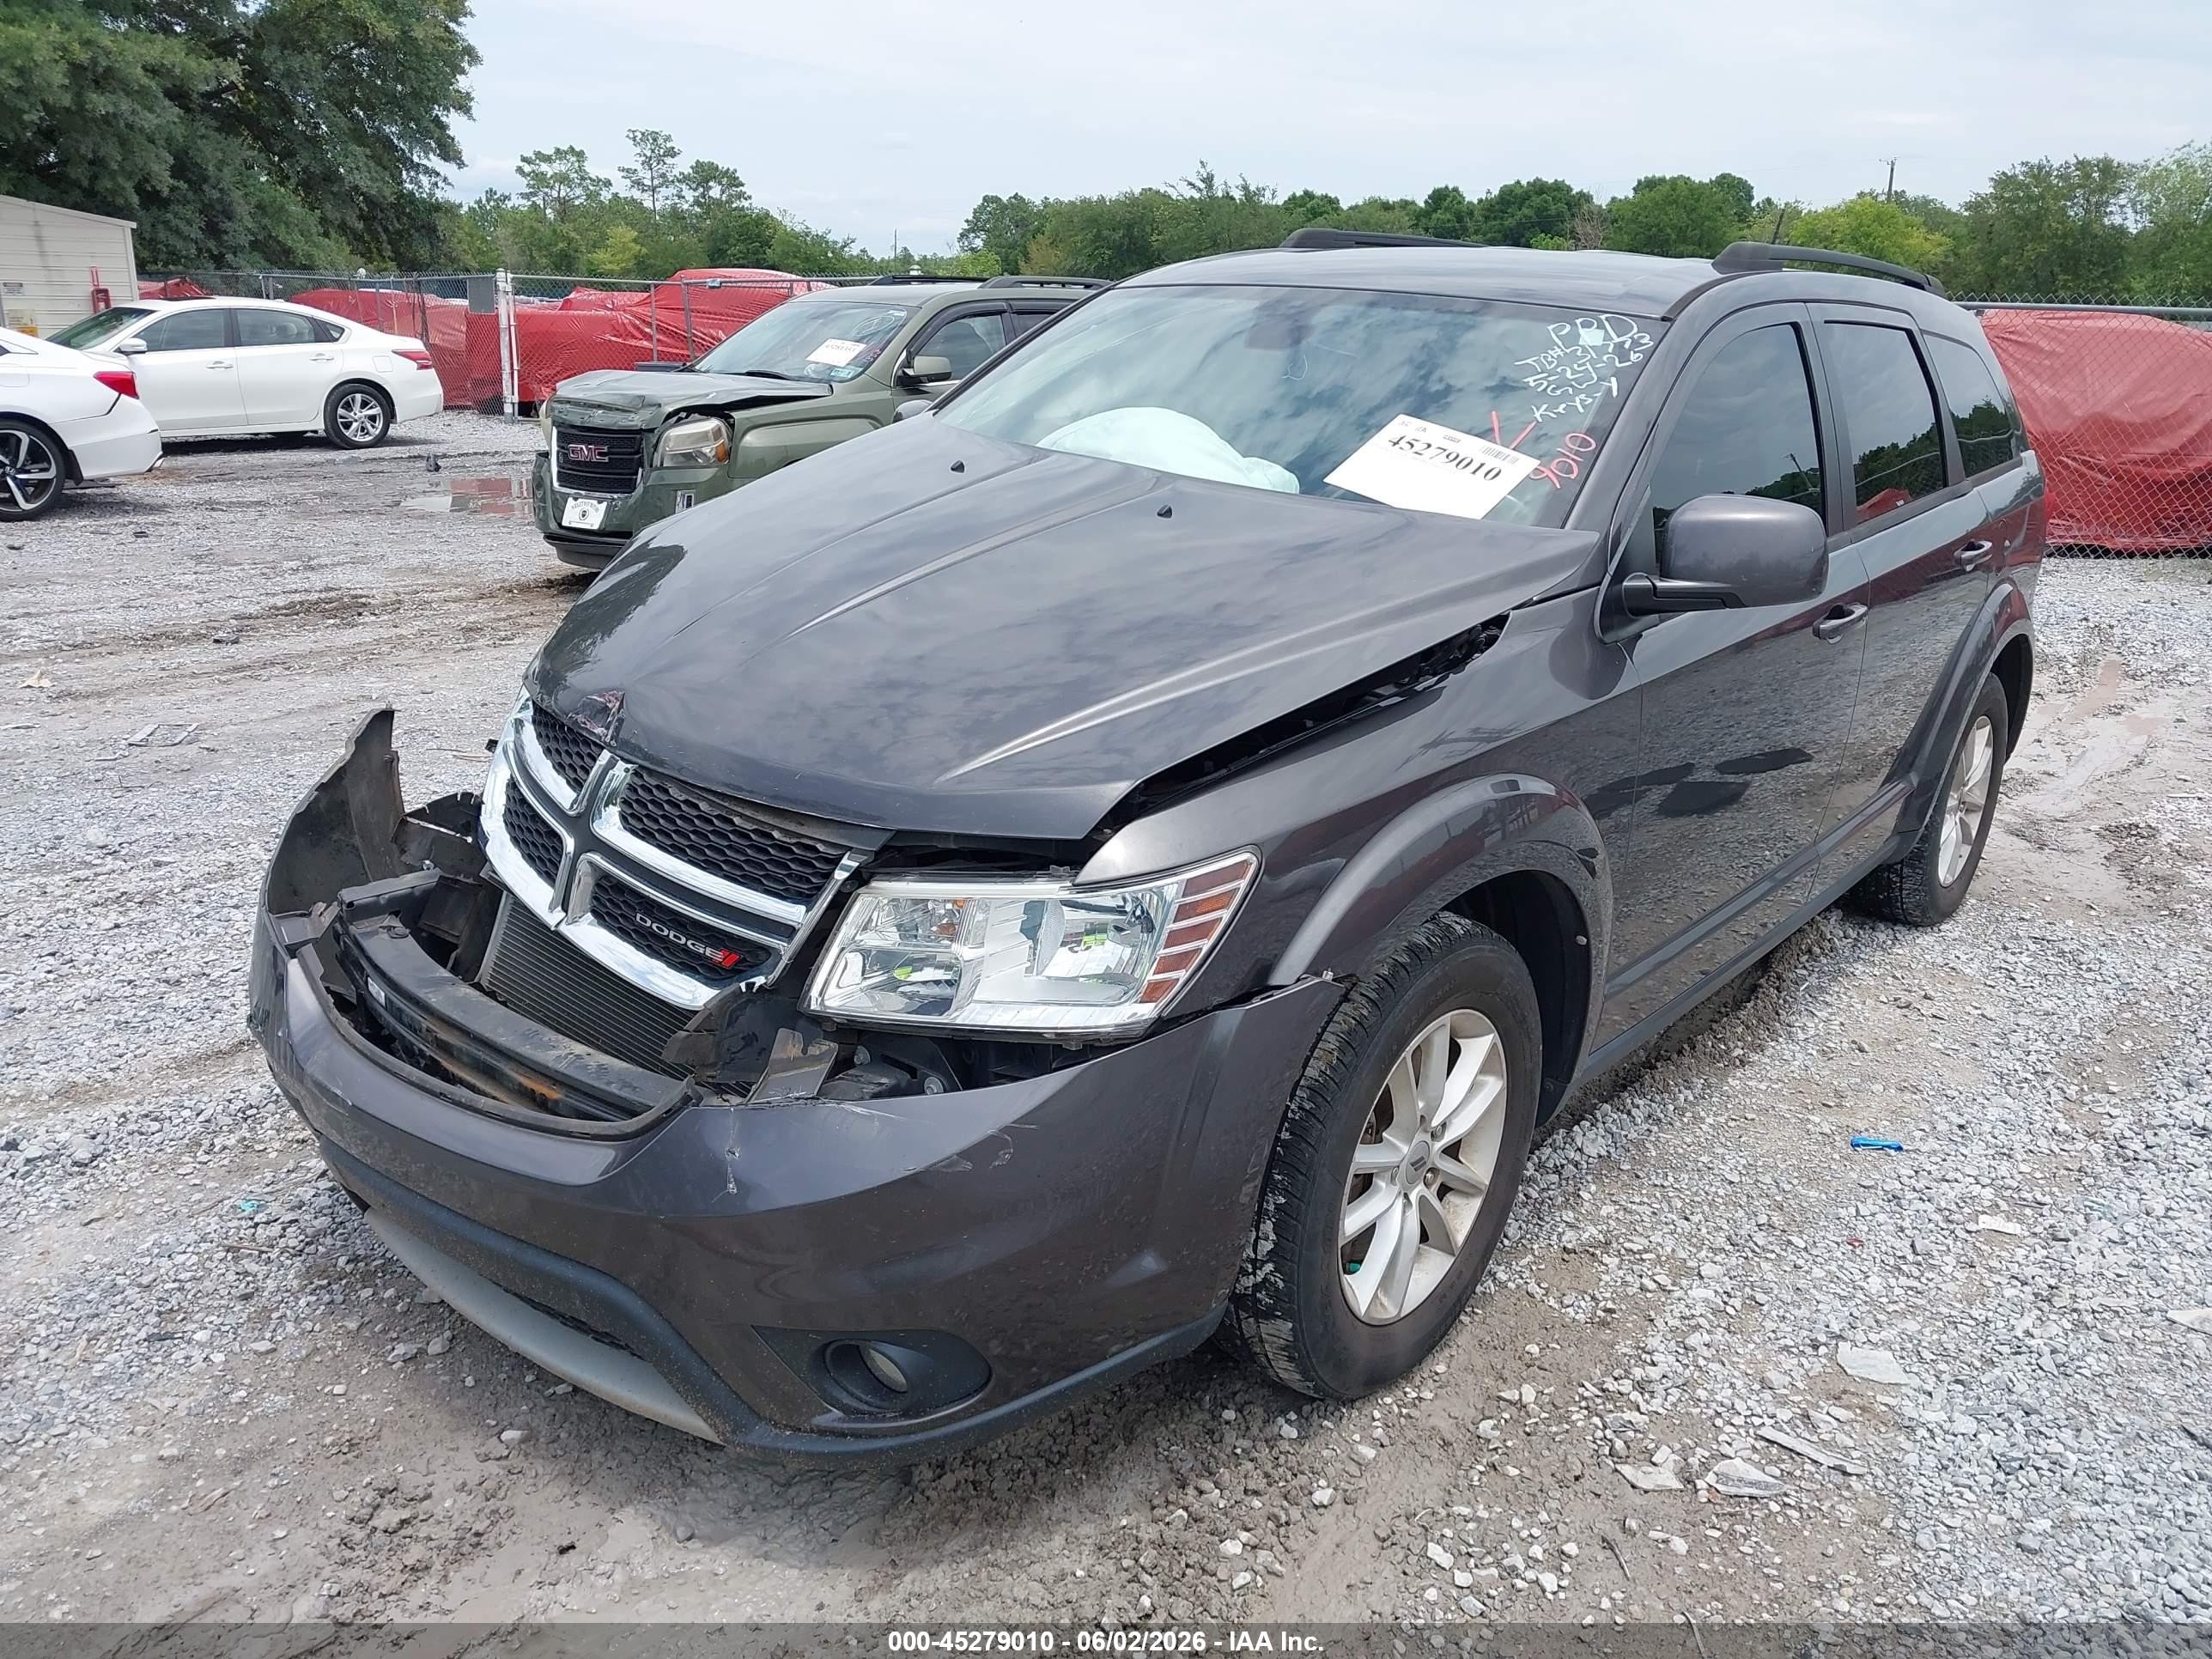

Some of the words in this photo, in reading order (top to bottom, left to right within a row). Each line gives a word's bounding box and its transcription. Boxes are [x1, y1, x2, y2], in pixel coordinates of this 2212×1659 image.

[568, 444, 609, 462] GMC
[1388, 434, 1502, 482] 45279010
[635, 912, 725, 963] DODGE
